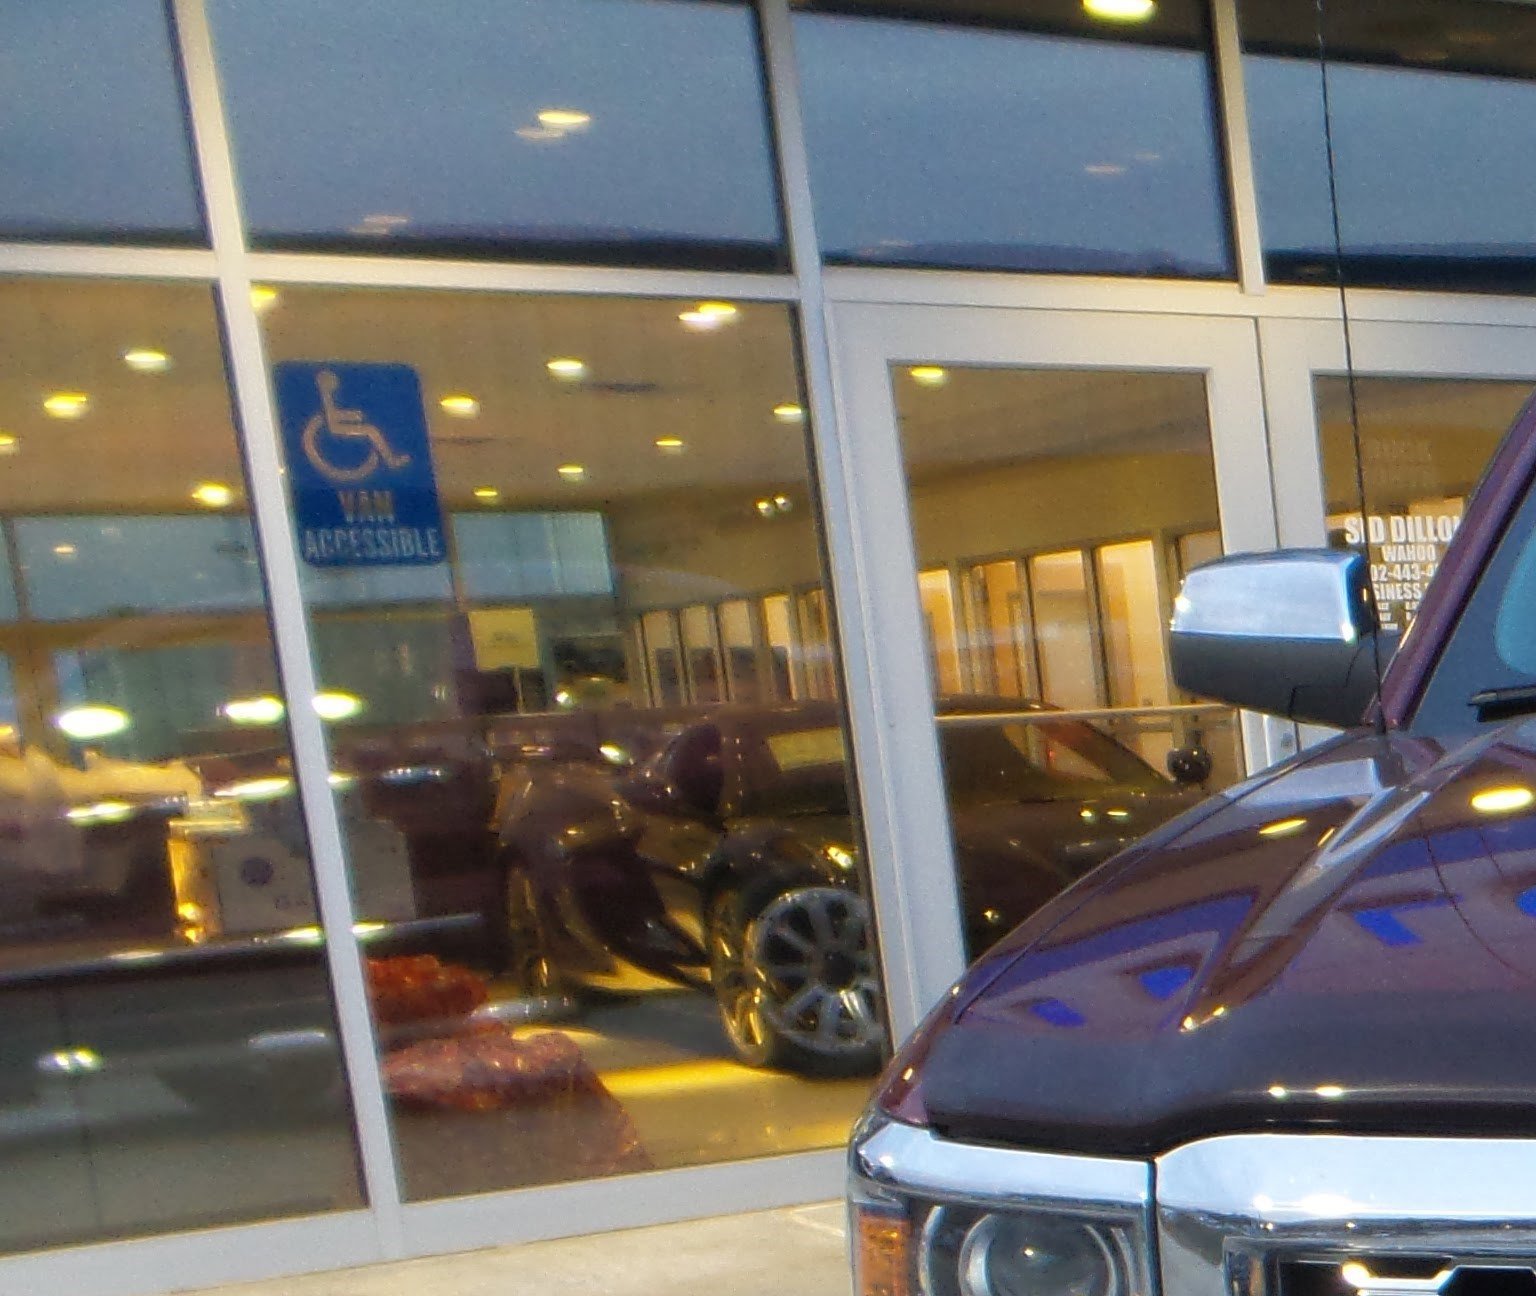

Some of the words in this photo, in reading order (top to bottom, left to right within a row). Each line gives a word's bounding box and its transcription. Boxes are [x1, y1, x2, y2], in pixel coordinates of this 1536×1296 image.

[339, 489, 395, 523] VAN
[303, 527, 441, 560] ACCESSIBLE
[1345, 515, 1386, 544] SID
[1381, 543, 1436, 562] WAHOO
